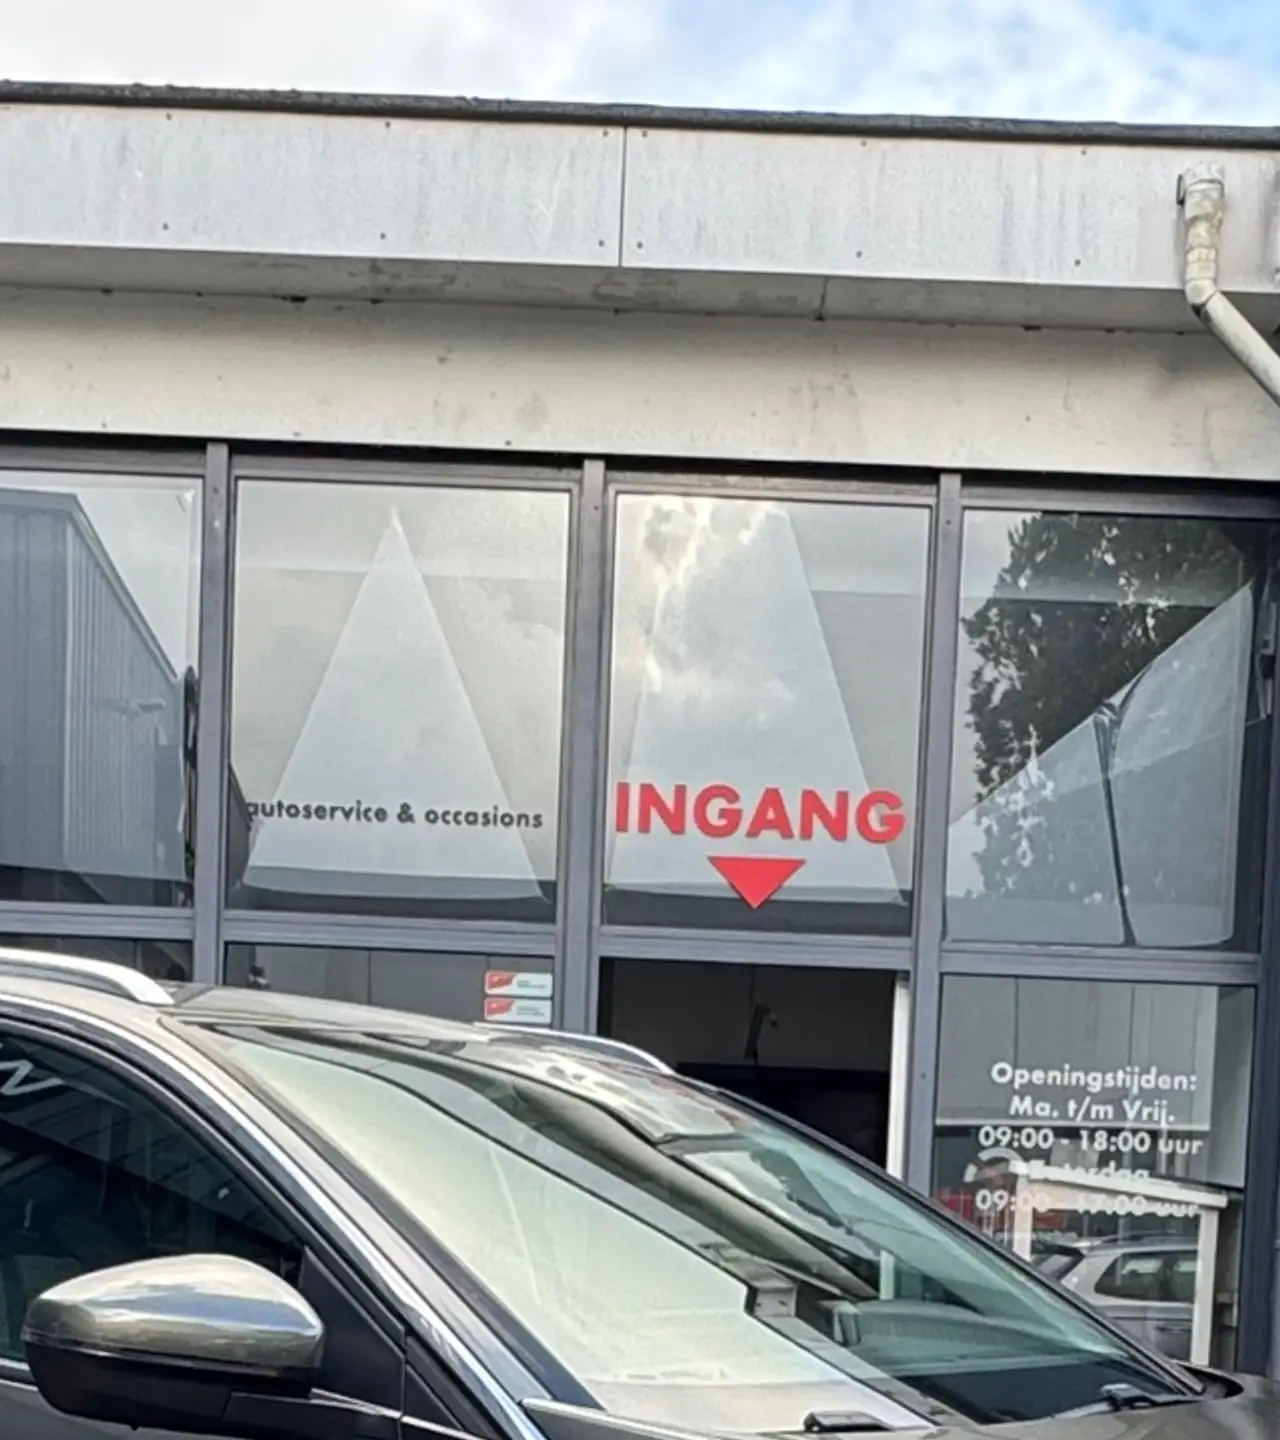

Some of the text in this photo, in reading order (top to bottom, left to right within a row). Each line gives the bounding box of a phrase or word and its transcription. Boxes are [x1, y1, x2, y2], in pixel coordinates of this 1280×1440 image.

[246, 798, 543, 829] autoservice & occasions
[615, 781, 907, 844] INGANG
[990, 1061, 1199, 1095] Openingstijden:
[1009, 1094, 1176, 1128] Ma. t/m Vrij.
[978, 1124, 1055, 1149] 09:00
[1079, 1129, 1152, 1154] 18:00
[1157, 1136, 1204, 1155] uur
[974, 1188, 1051, 1214] 09:00
